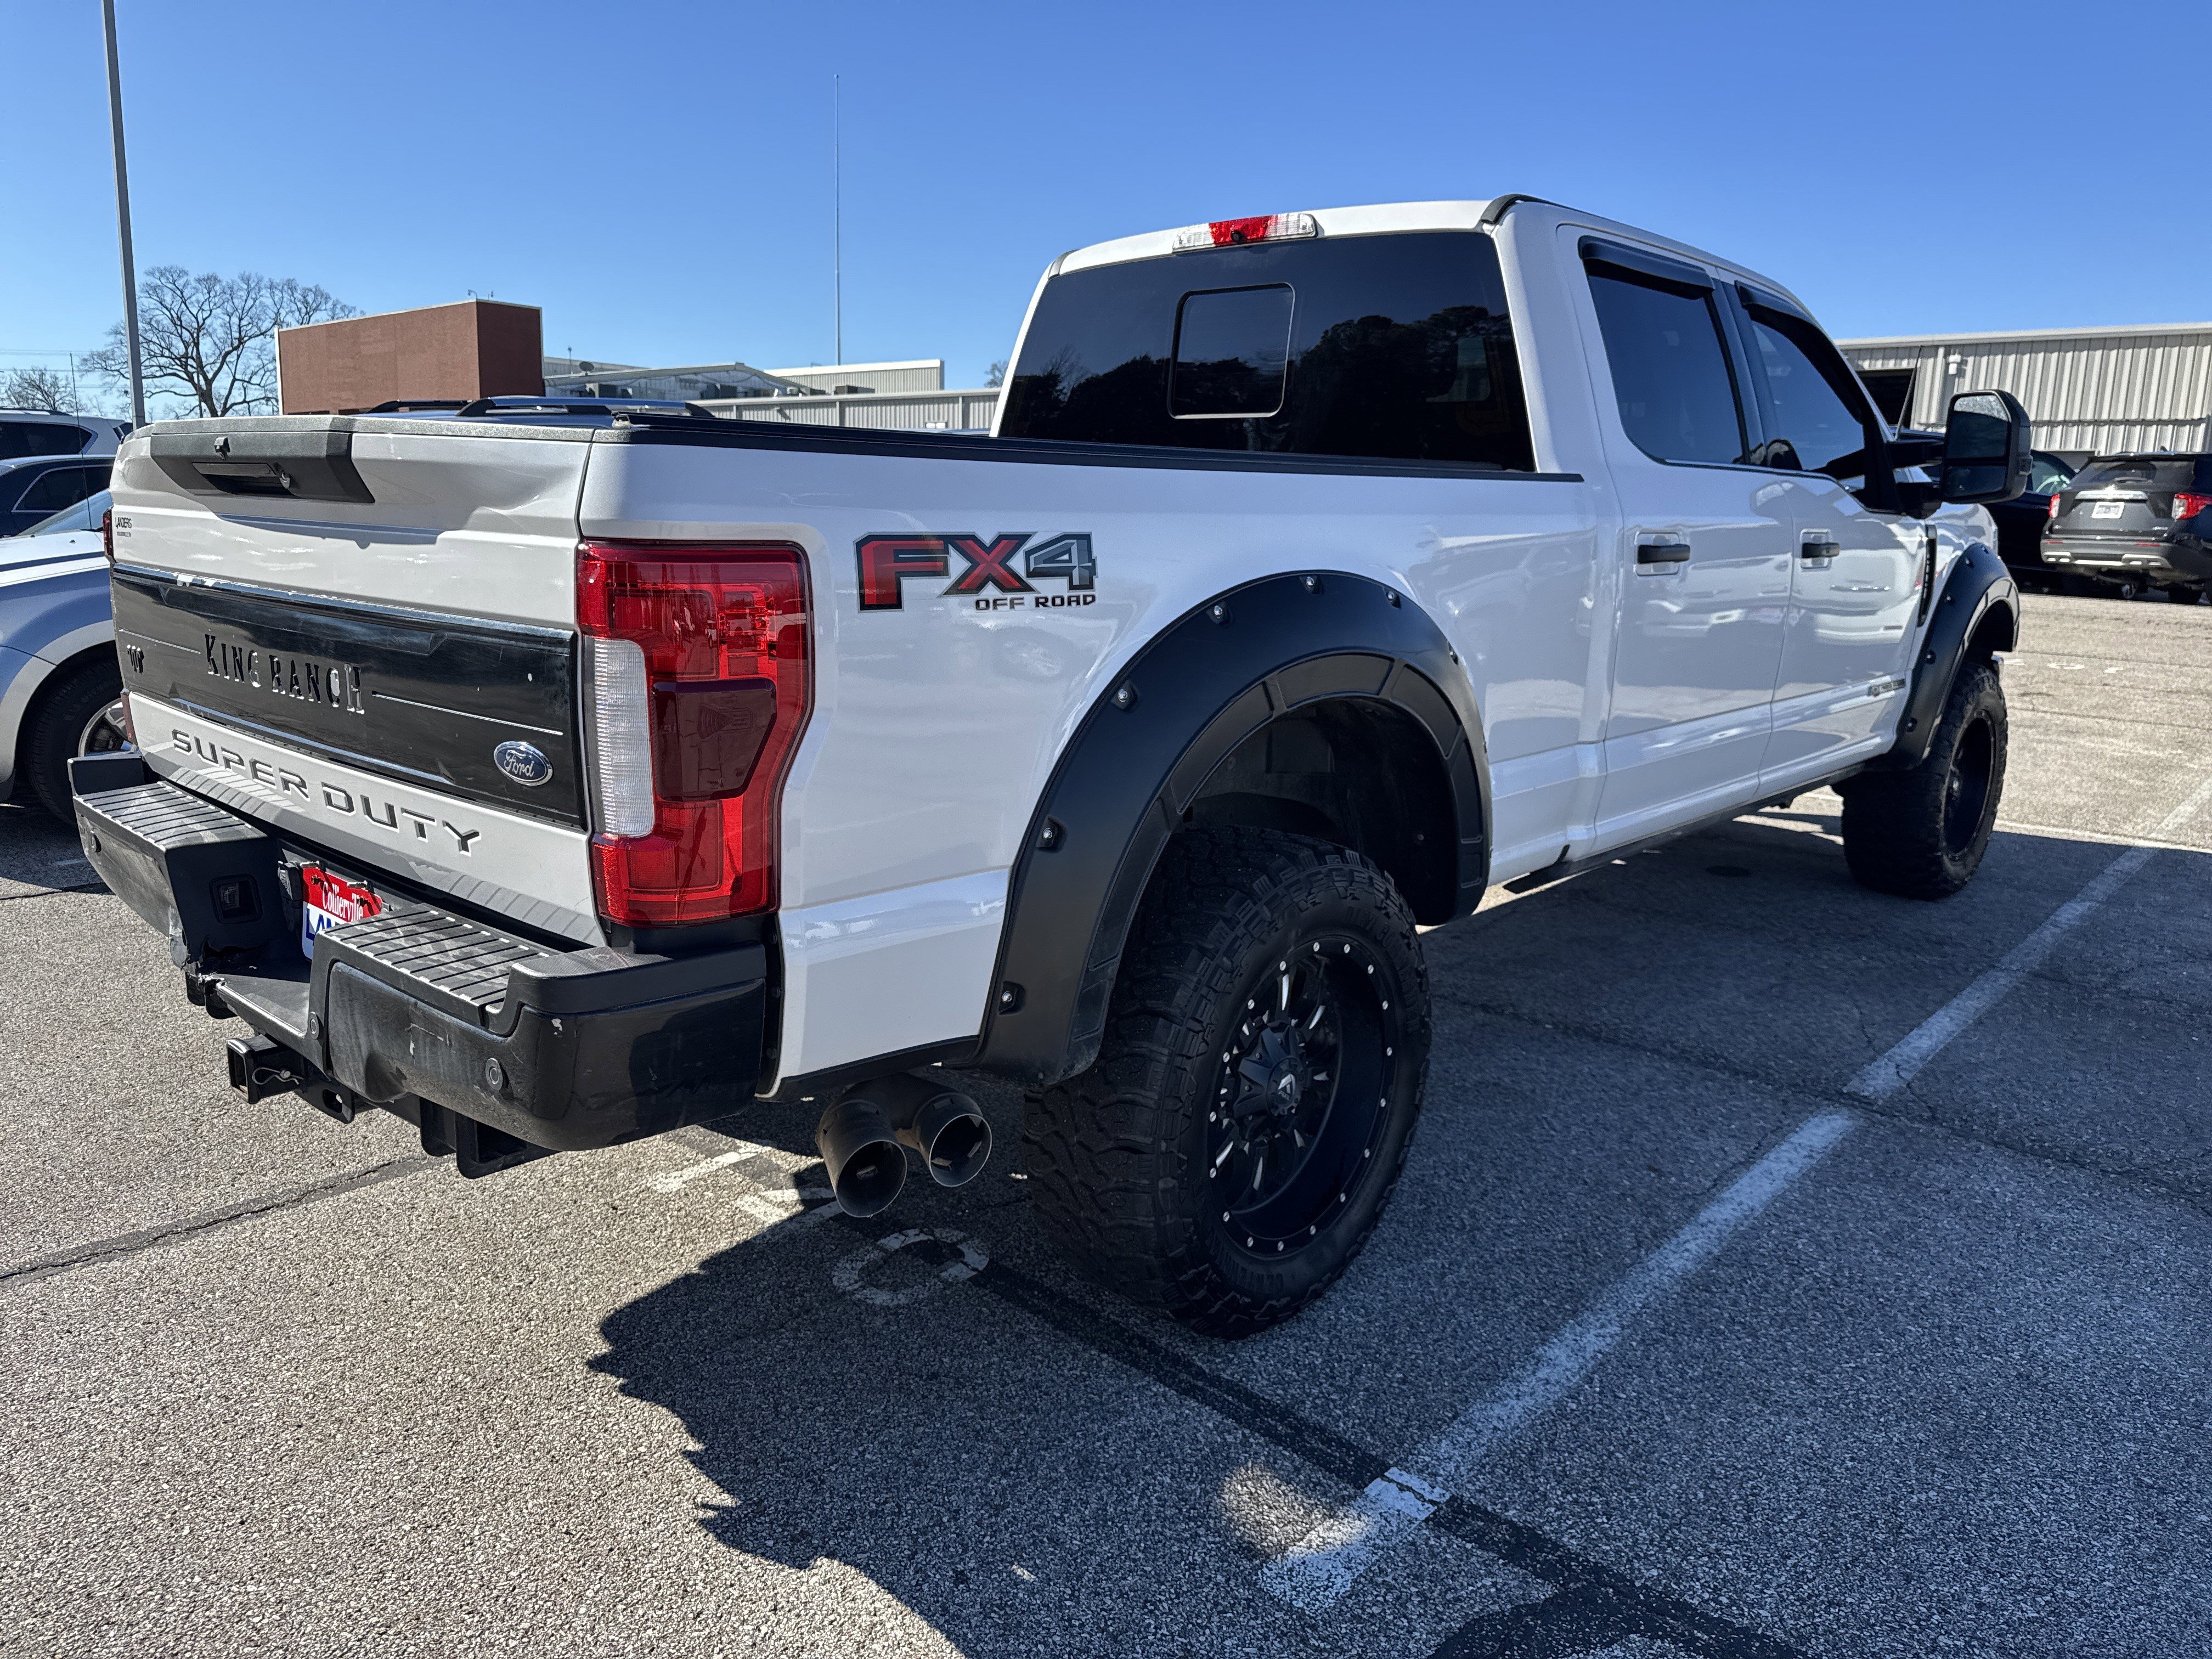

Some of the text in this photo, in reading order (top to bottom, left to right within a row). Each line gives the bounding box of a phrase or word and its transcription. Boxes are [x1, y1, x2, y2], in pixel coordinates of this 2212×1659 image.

[115, 517, 132, 529] LANDERS
[854, 531, 1098, 614] FX4
[975, 594, 1097, 612] OFF ROAD
[205, 634, 365, 714] KING RANCH
[504, 749, 535, 778] Ford
[171, 728, 482, 857] SUPER DUTY
[322, 881, 364, 923] Collierville
